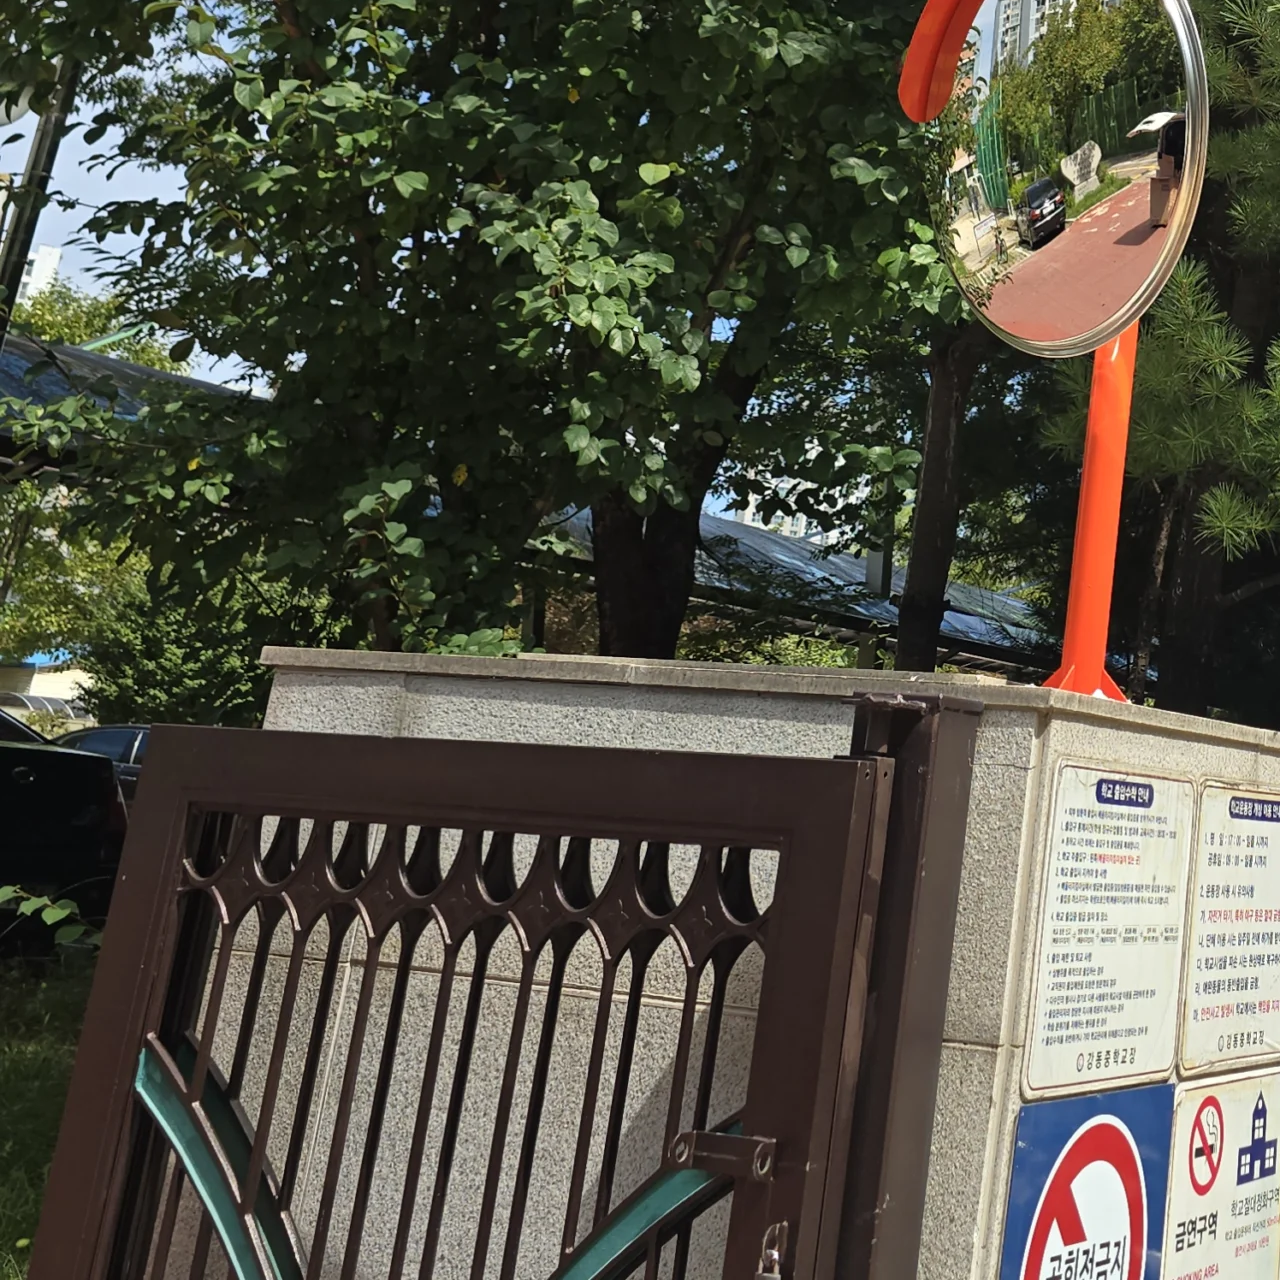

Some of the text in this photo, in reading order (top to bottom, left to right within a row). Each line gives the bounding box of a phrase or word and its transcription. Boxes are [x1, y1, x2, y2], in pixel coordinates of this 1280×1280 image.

[1101, 783, 1149, 803] 학교 출입수칙 안내
[1230, 800, 1253, 816] 학교운동장
[1263, 804, 1272, 818] 이용
[1206, 885, 1220, 898] 운동장
[1221, 885, 1231, 898] 사용
[1237, 885, 1255, 898] 유의사항
[1207, 910, 1223, 923] 자전거
[1204, 956, 1227, 971] 학교시설을
[1202, 979, 1226, 995] 애완동물의
[1200, 1005, 1220, 1021] 안전사고
[1235, 1001, 1257, 1017] 학교에서는
[1226, 1029, 1264, 1051] 강동중학교장
[1086, 1047, 1136, 1071] 강동중학교장
[1231, 1187, 1280, 1219] 학교절대정화구역
[1175, 1210, 1218, 1253] 금연구역
[1204, 1262, 1219, 1279] AREA
